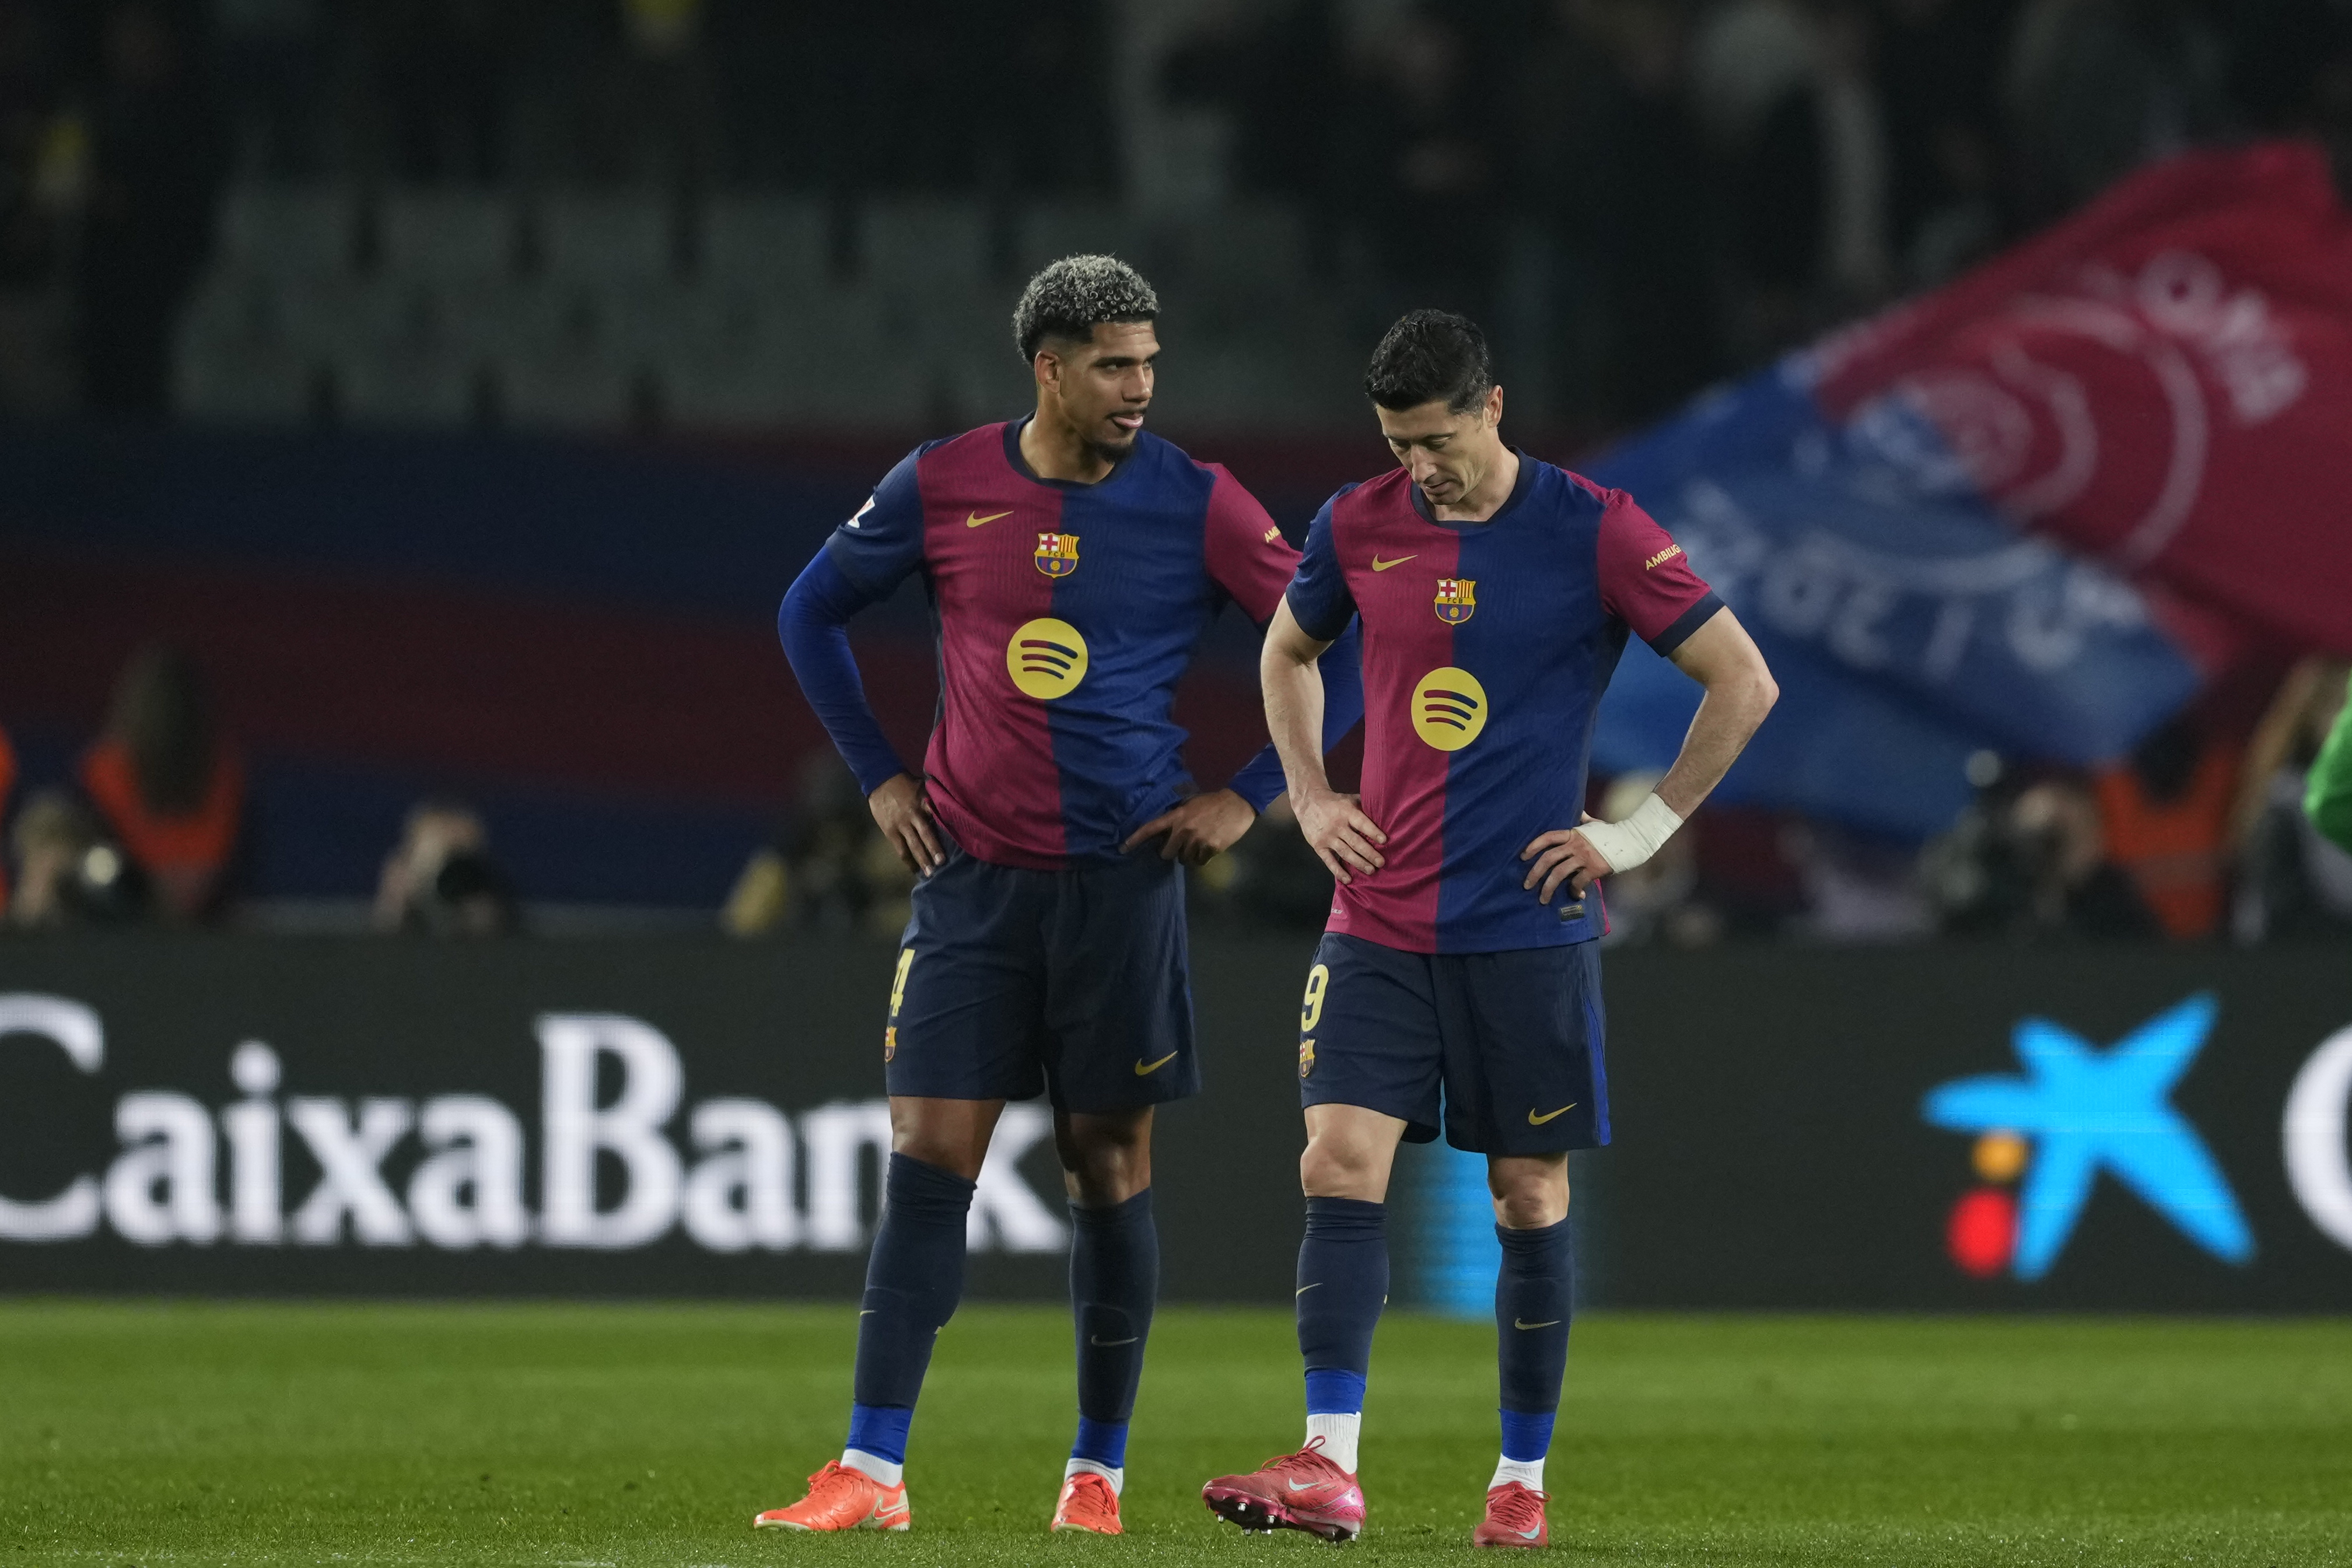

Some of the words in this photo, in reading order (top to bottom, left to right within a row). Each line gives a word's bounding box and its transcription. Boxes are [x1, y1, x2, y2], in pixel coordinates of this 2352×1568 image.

[1646, 544, 1682, 571] AMBILIG
[890, 948, 916, 1017] 4
[1301, 964, 1329, 1032] 9
